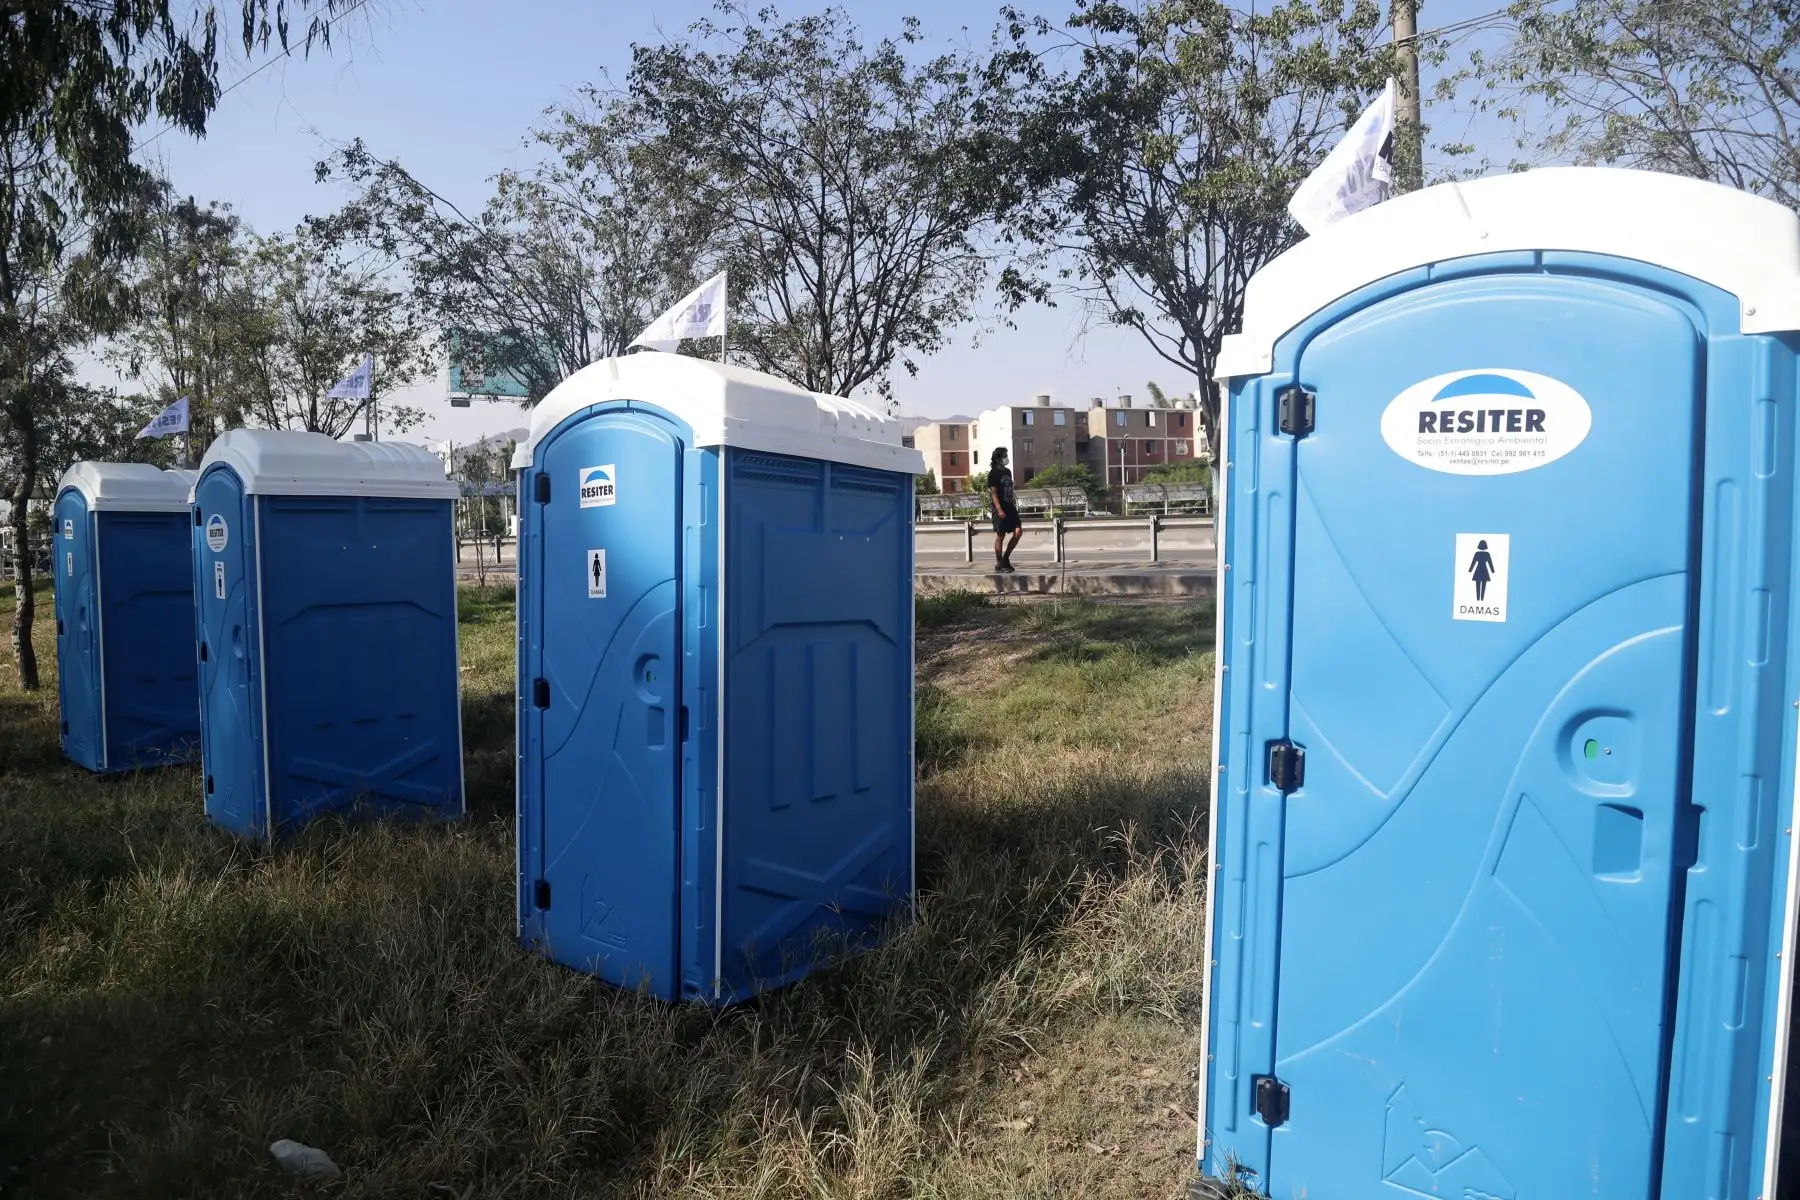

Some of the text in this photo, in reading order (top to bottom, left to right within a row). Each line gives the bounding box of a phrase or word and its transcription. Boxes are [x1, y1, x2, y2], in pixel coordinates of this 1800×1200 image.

[1418, 408, 1546, 434] RESITER
[1417, 436, 1441, 445] Socio
[1497, 435, 1548, 445] Ambiental
[581, 485, 614, 498] RESITER
[1460, 605, 1500, 616] DAMAS
